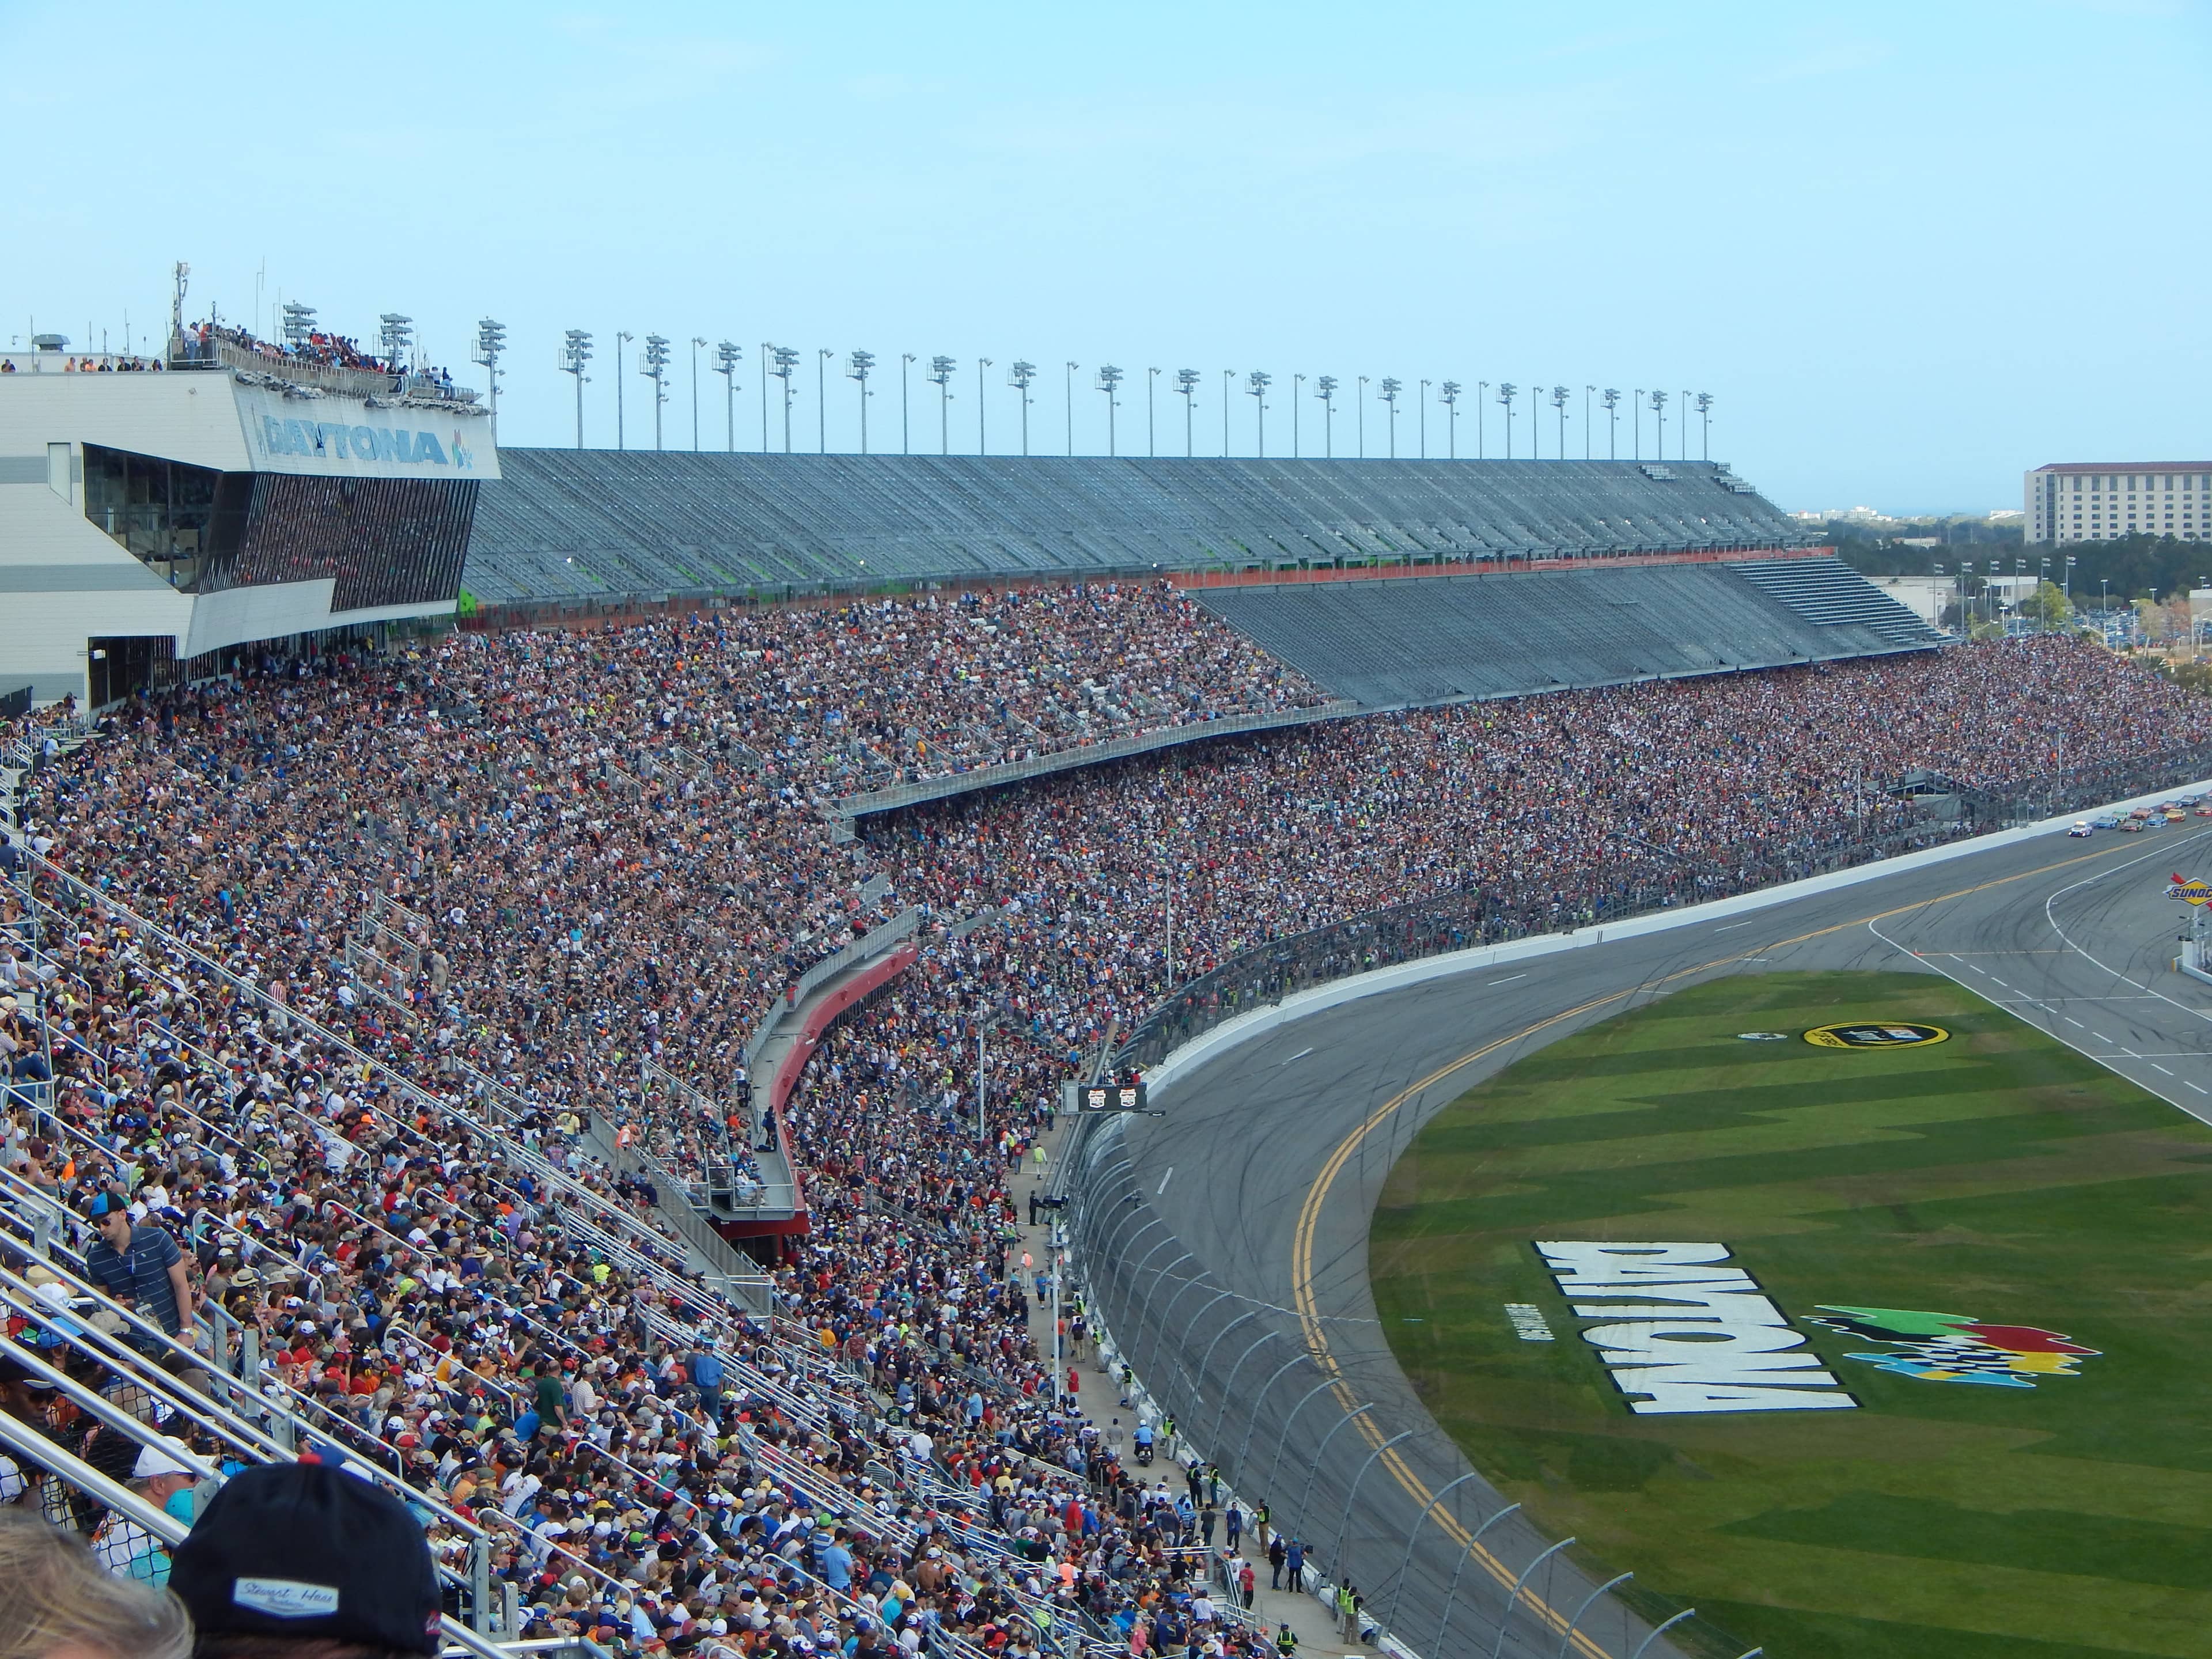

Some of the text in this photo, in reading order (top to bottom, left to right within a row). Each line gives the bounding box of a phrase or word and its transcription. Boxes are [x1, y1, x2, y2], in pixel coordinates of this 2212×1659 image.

[263, 415, 449, 465] DAYTONA
[1531, 1241, 1862, 1414] DAYTONA
[240, 1582, 290, 1598] Stewart
